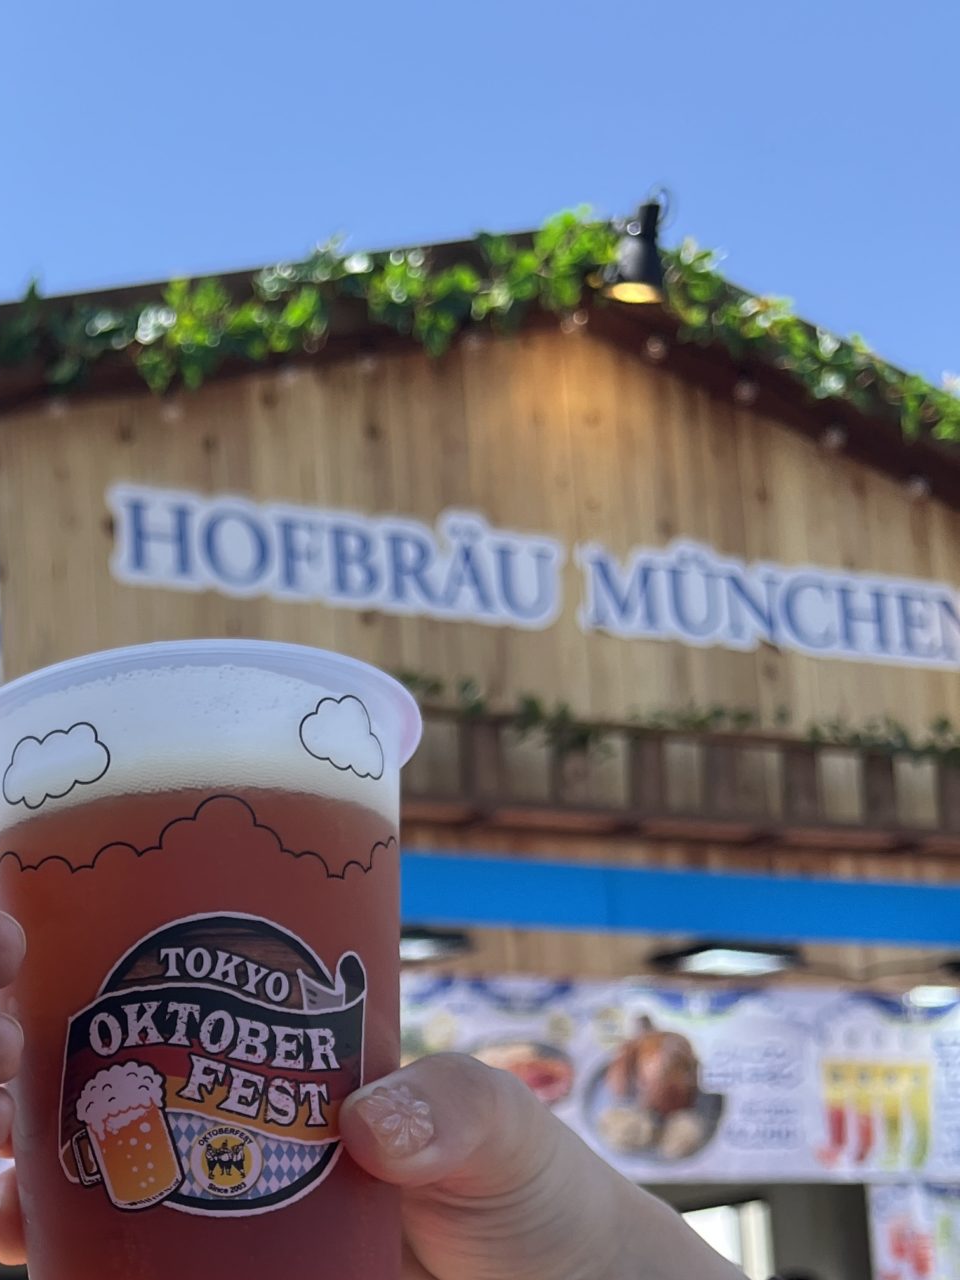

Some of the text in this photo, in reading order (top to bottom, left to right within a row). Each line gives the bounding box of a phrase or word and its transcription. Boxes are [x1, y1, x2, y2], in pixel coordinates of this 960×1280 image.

[123, 494, 556, 619] HOFBRÄU
[160, 947, 290, 1001] TOKYO
[88, 1001, 341, 1071] OKTOBER
[176, 1054, 330, 1126] FEST
[198, 1127, 253, 1146] OKTOBERFEST
